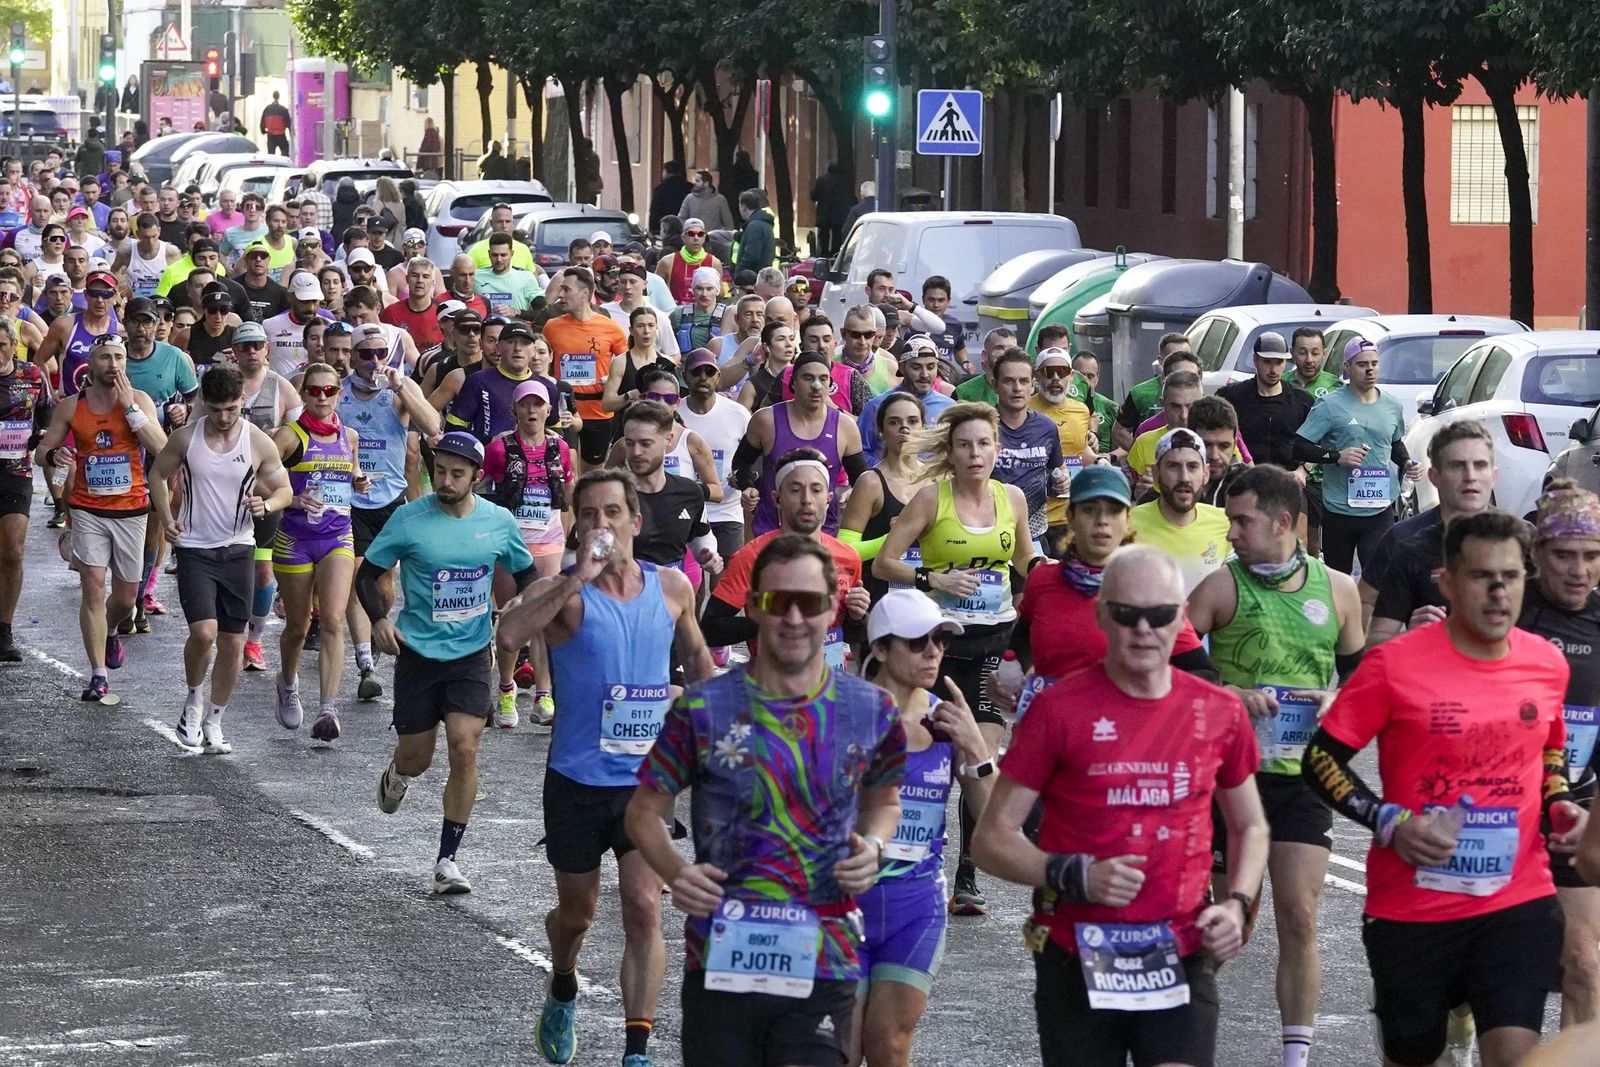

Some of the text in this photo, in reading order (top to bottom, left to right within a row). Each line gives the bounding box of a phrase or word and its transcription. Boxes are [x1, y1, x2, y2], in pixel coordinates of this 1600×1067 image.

[359, 462, 377, 470] RRY
[88, 476, 131, 486] JESUS G.S.
[324, 472, 348, 480] ZURICH
[1356, 490, 1383, 498] ALEXIS
[454, 568, 483, 579] ZURICH
[434, 591, 486, 609] XANKLY 11
[631, 710, 653, 719] 6117
[1280, 712, 1301, 722] 7211
[1562, 710, 1594, 721] URICH
[613, 722, 661, 738] CHESCO
[1107, 761, 1169, 774] GENERALI
[898, 785, 943, 799] ZURICH
[1107, 784, 1170, 806] MÁLAGA
[902, 810, 921, 821] 928
[1466, 812, 1508, 824] URICH
[1446, 856, 1503, 874] ANUEL
[750, 905, 807, 921] ZURICH
[748, 933, 779, 947] 8907
[1110, 925, 1162, 943] ZURICH
[731, 950, 792, 973] PJOTR
[1093, 967, 1176, 991] RICHARD
